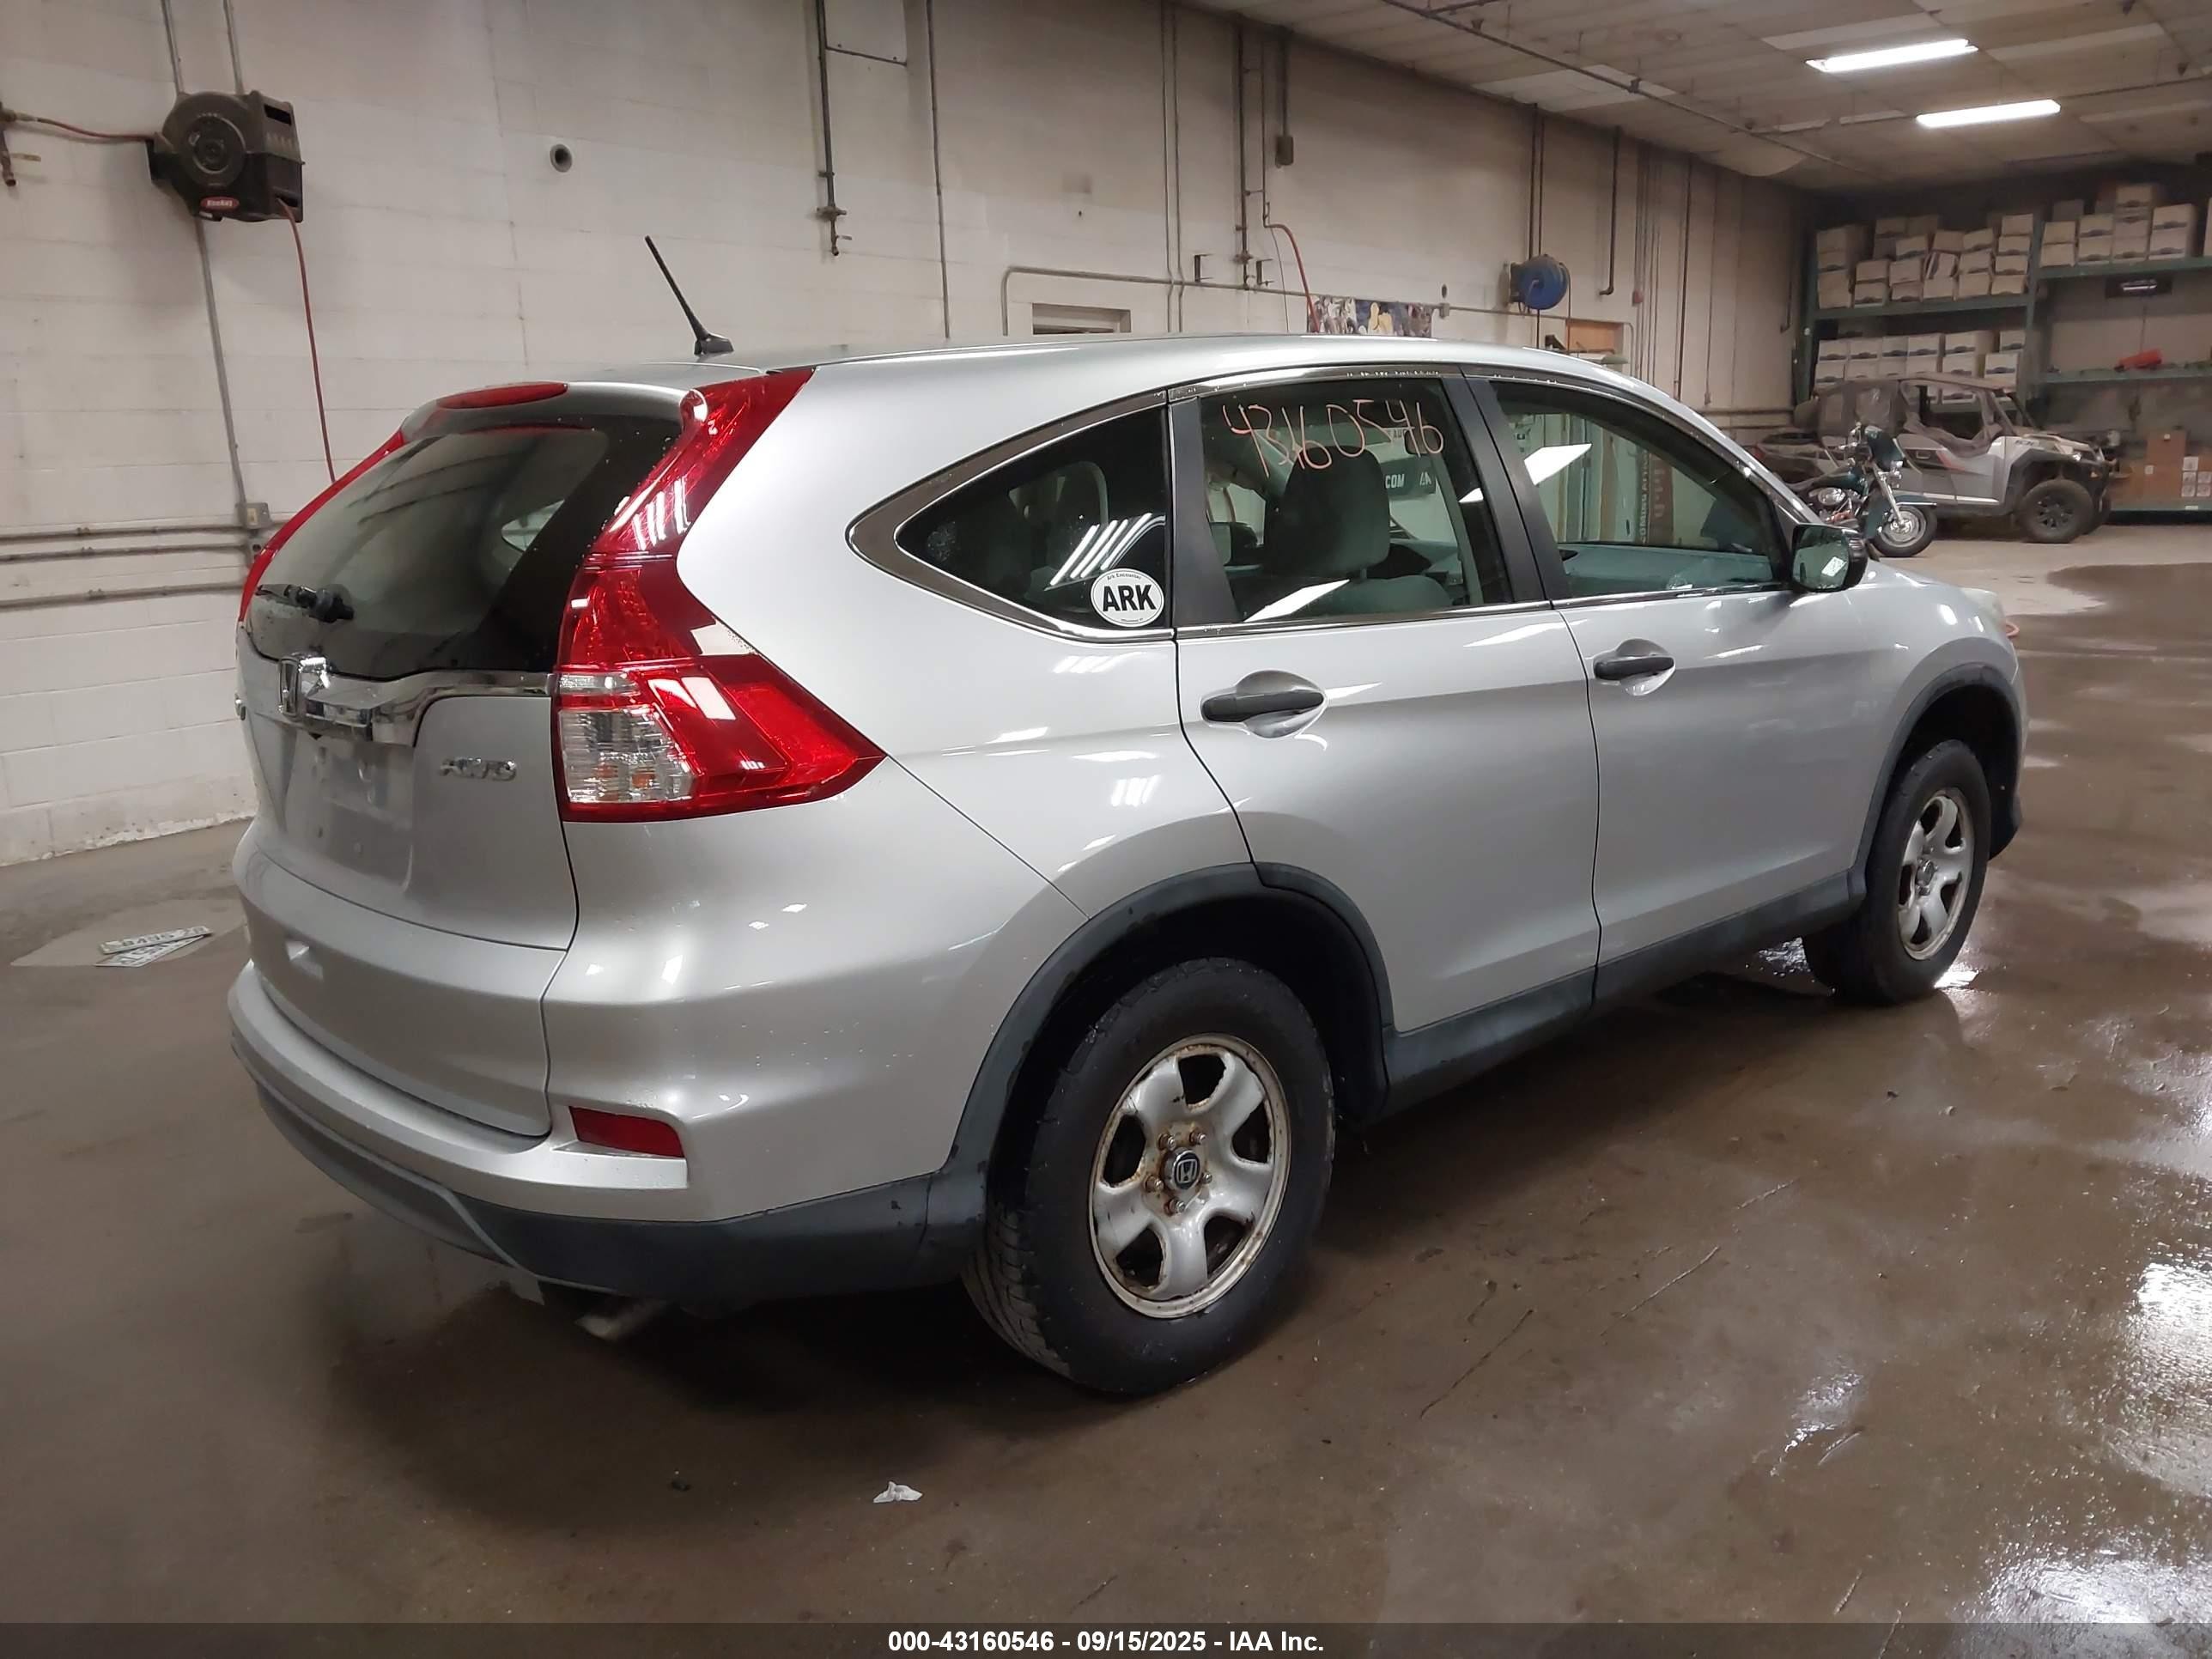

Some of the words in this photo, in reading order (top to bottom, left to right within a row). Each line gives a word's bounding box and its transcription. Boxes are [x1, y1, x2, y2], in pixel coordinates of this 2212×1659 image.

[1223, 399, 1444, 478] 43160546
[1385, 473, 1405, 489] COM
[1103, 584, 1157, 612] ARK
